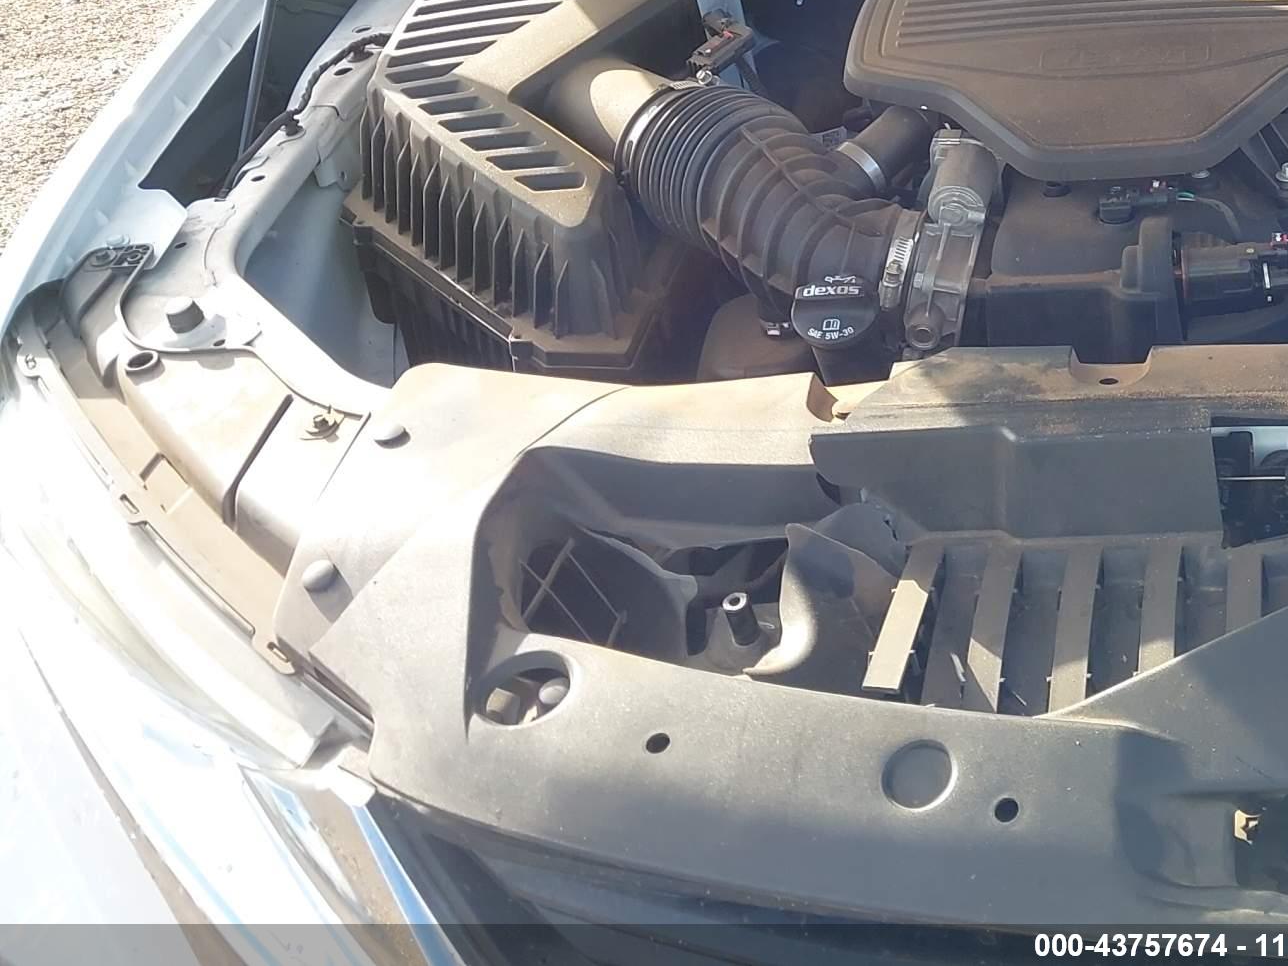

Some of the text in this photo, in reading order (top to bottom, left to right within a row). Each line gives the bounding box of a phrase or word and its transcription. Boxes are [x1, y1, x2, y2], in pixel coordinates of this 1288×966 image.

[803, 284, 862, 297] dexos
[807, 326, 855, 340] SAE 5W-30
